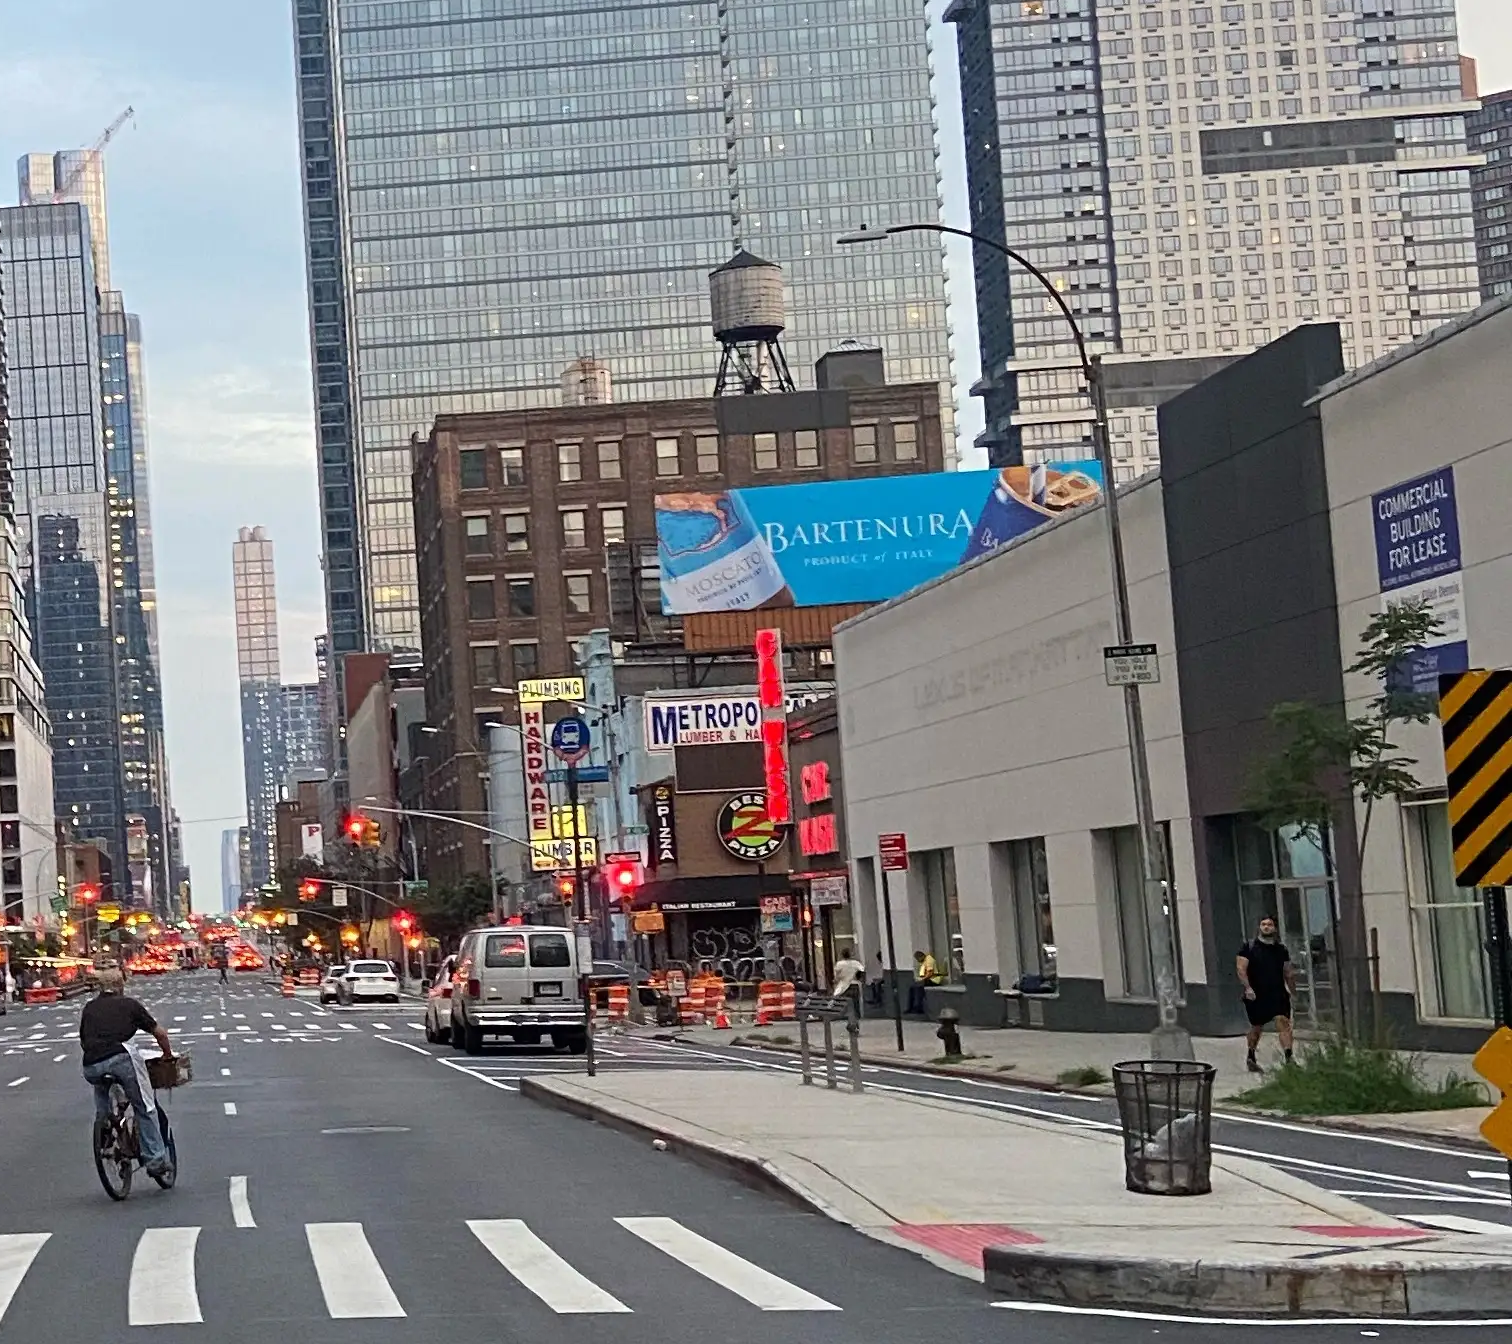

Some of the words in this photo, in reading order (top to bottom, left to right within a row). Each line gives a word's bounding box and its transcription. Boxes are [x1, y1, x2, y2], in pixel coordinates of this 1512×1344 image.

[1378, 478, 1448, 520] COMMERCIAL
[763, 508, 974, 554] BARTENURA
[1390, 508, 1441, 543] BUILDING
[804, 554, 867, 567] PRODUCT
[874, 552, 887, 563] of
[895, 549, 933, 560] ITALY
[1389, 545, 1412, 572] FOR
[1412, 533, 1448, 564] LEASE
[685, 549, 762, 598] MOSCATO
[522, 680, 581, 699] PLUMBING
[651, 701, 759, 745] METROPO
[679, 730, 724, 744] LUMBER
[525, 712, 547, 830] HARDWARE
[729, 795, 766, 811] BES
[534, 841, 593, 858] LUMBR
[657, 805, 675, 860] PIZZA
[728, 839, 780, 857] PIZZA
[764, 896, 786, 906] CAR
